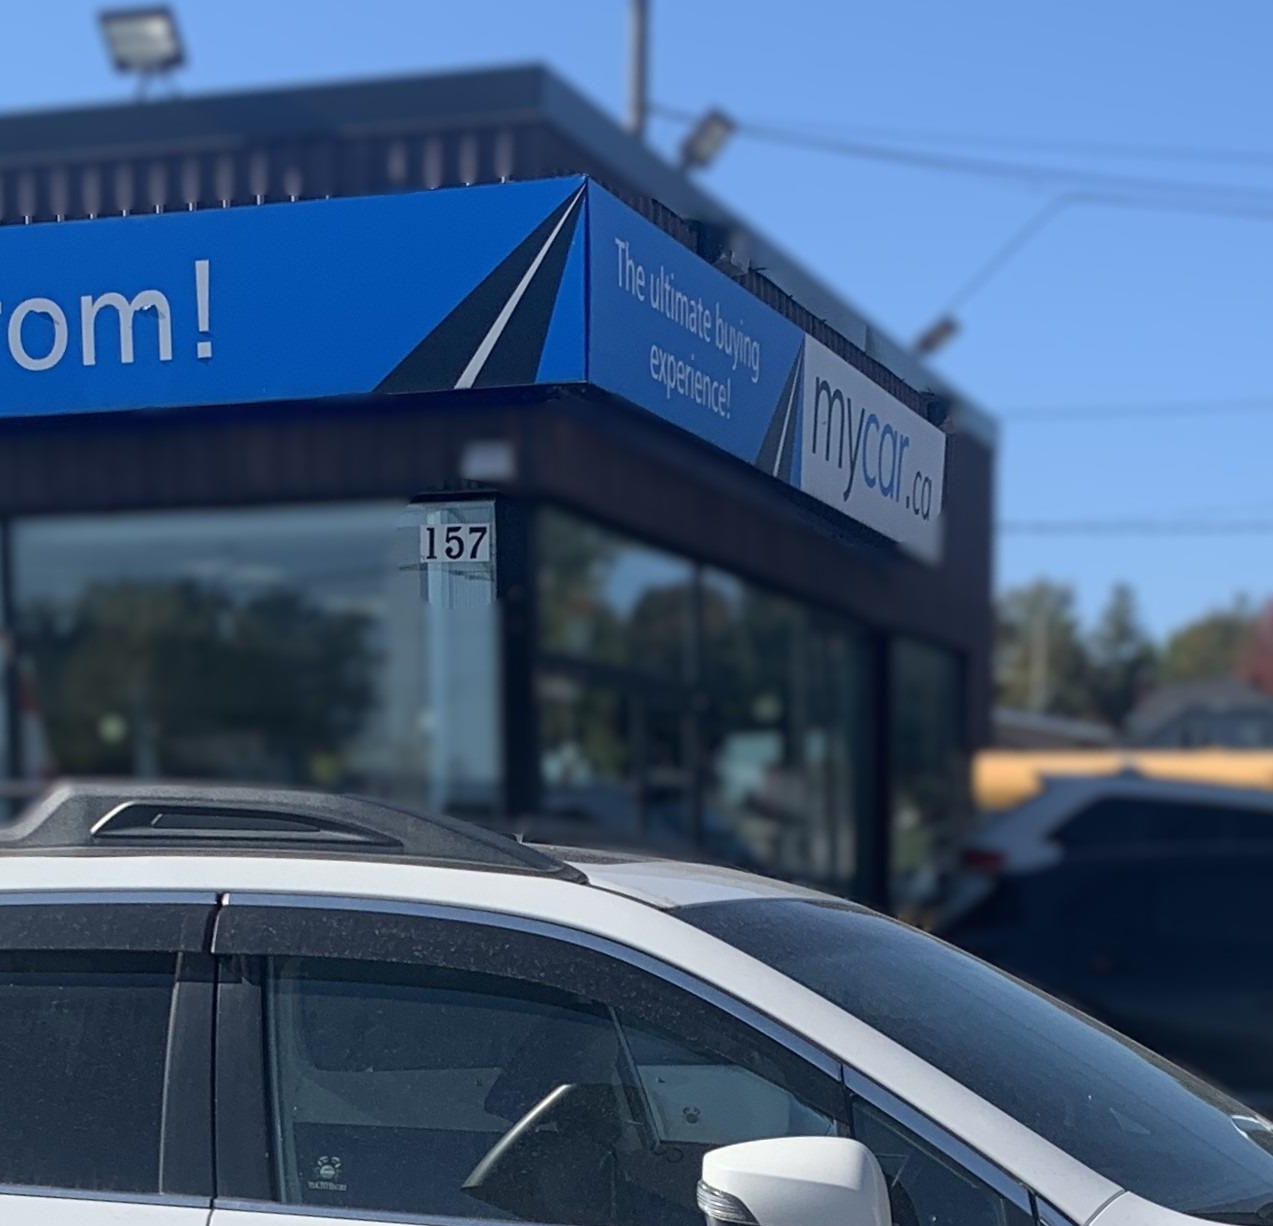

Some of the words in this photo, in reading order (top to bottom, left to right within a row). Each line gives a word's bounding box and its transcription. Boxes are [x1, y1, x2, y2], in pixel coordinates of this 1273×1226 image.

[615, 238, 645, 301] The
[650, 266, 711, 342] ultimate
[715, 302, 760, 383] buying
[650, 345, 730, 419] experience!
[812, 376, 932, 520] mycar.ca
[425, 525, 488, 560] 157
